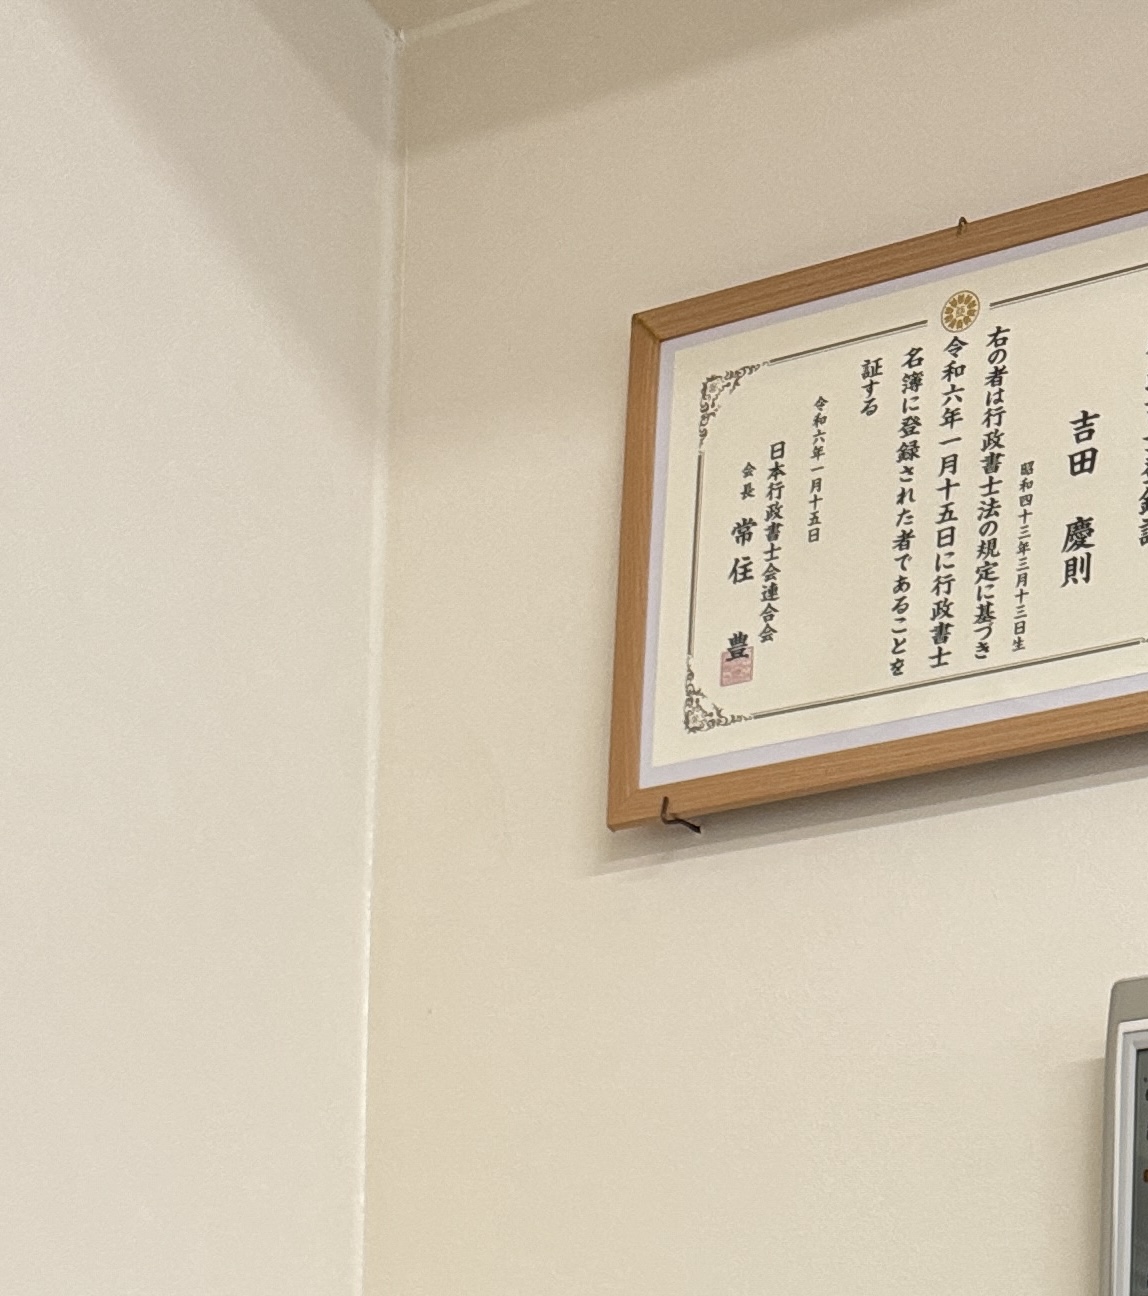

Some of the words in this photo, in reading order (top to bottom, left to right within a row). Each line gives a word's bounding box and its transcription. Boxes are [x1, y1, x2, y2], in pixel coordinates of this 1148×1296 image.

[861, 358, 883, 416] 証する
[1068, 410, 1100, 476] 吉田
[740, 462, 756, 500] 会長
[759, 441, 786, 643] 日本行政書士会連合会
[808, 396, 828, 542] 令和六年一月十五日
[890, 347, 924, 676] 名簿に登録された者であることを
[929, 336, 968, 668] 令和六年一月十五日に行政書士
[974, 326, 1010, 659] 右の者は行政書士法の規定に基づき
[1012, 461, 1034, 652] 昭和四十三年三月十三日生
[1062, 517, 1095, 587] 慶則
[726, 632, 749, 662] 豊
